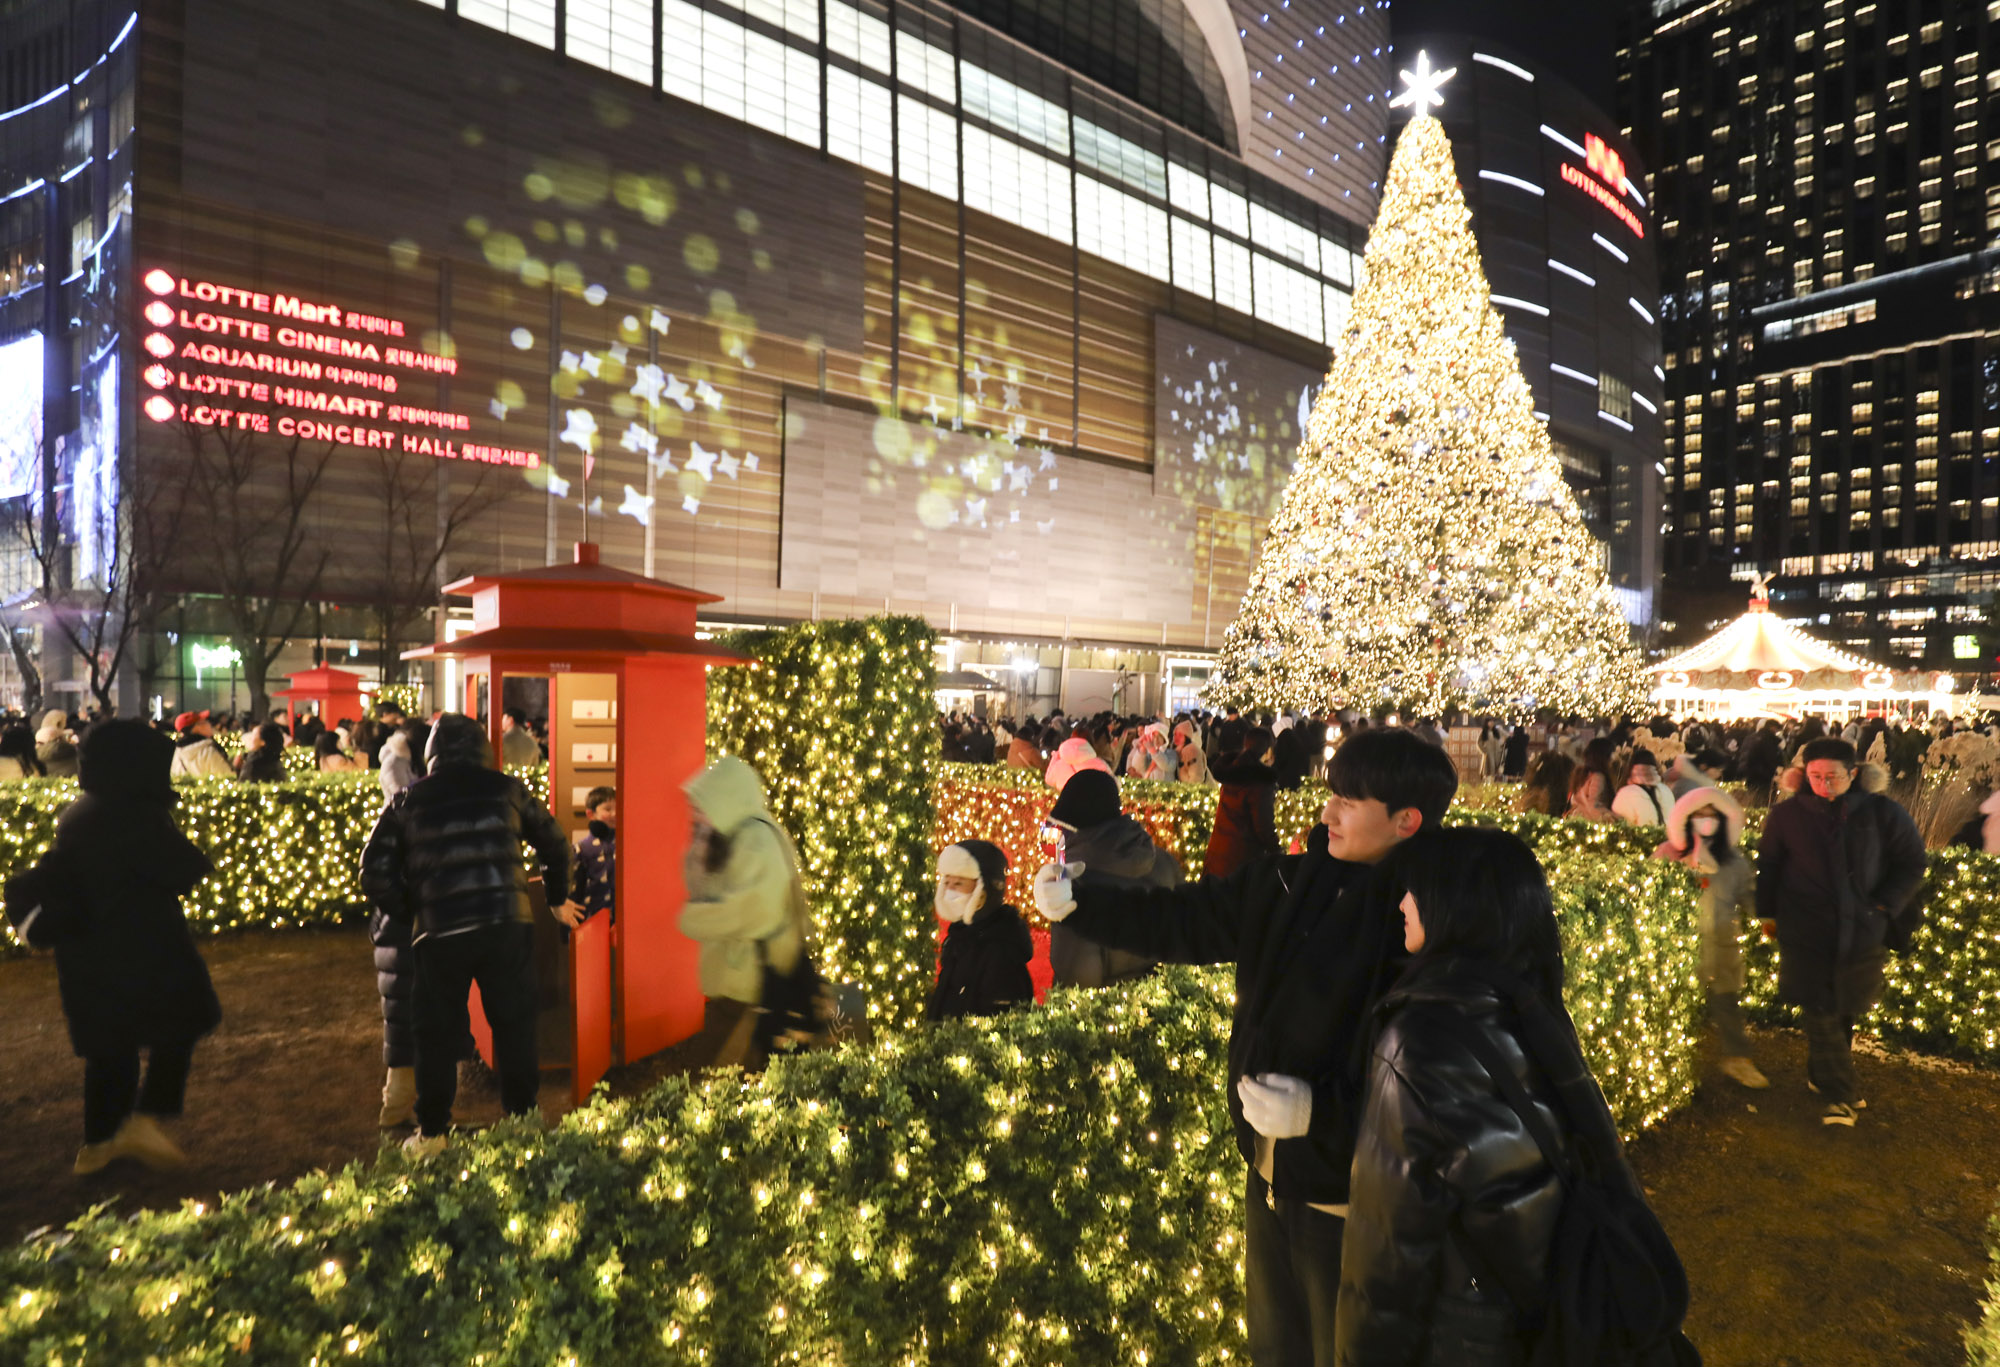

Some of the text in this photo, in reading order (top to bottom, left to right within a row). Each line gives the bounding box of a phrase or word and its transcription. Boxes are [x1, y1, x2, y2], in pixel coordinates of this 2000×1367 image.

[1561, 162, 1597, 197] LOTTE
[179, 279, 405, 337] LOTTE Mart 롯데마트
[179, 310, 458, 375] LOTTE CINEMA 롯데시네마
[181, 342, 398, 393] AQUARIUM 아쿠아리움
[179, 372, 471, 430] LOTTE HIMART 롯데하이마트
[277, 417, 395, 450] CONCERT
[403, 435, 457, 458] HALL
[462, 443, 539, 469] 롯데콘서트홀
